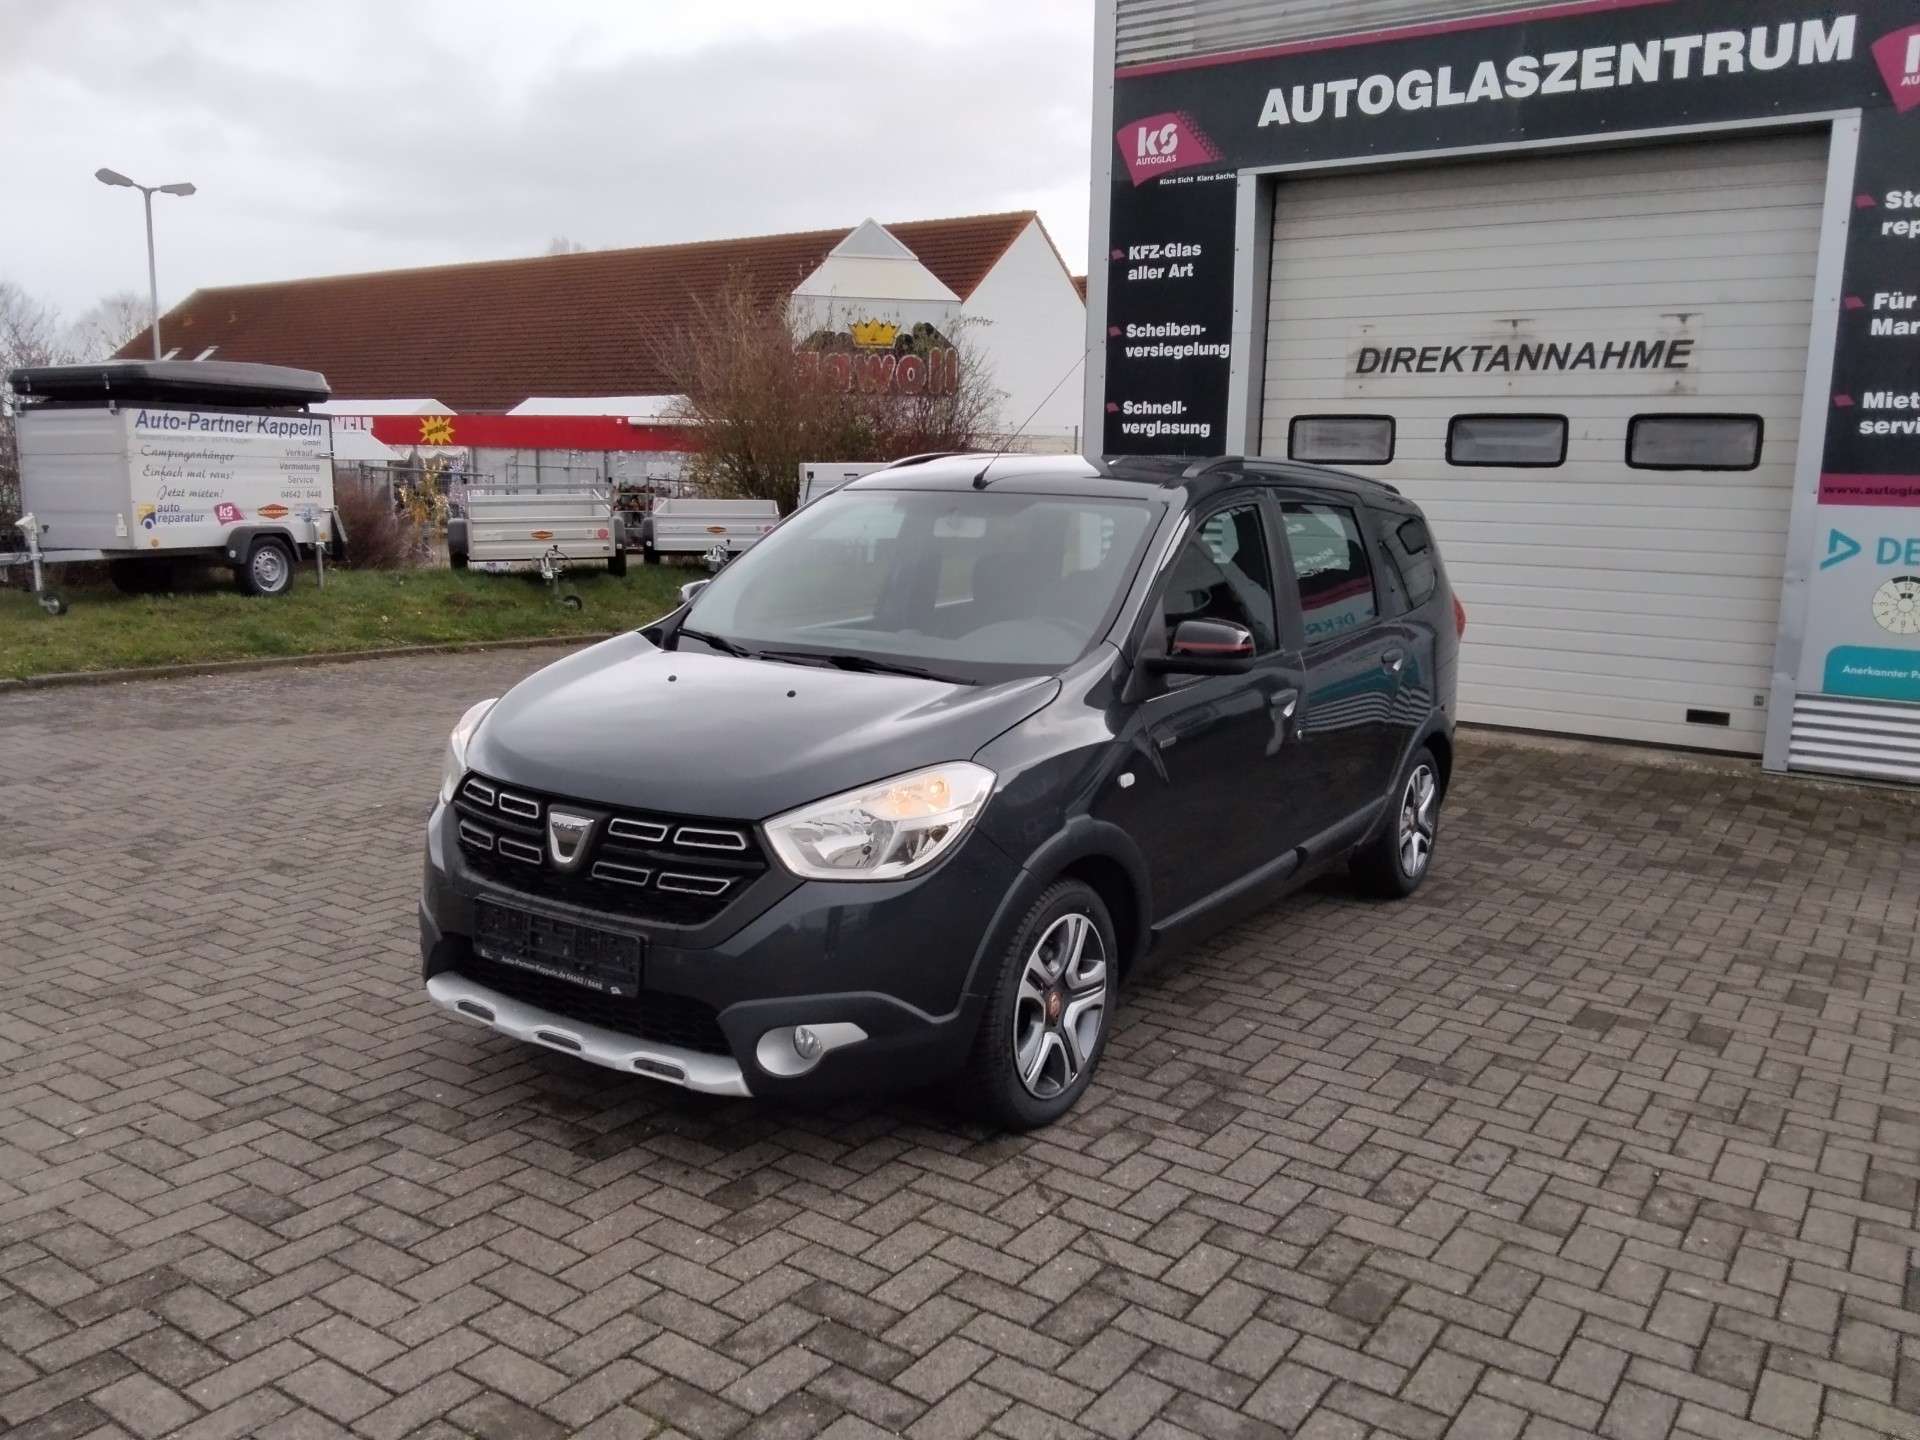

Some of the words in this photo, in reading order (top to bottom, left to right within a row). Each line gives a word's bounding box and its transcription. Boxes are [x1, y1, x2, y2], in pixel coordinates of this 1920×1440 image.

[1257, 15, 1857, 127] AUTOGLASZENTRUM
[1136, 155, 1177, 166] AUTOGLAS
[1885, 190, 1920, 209] St
[1881, 220, 1920, 239] rep
[1128, 243, 1202, 261] KFZ-Glas
[1127, 265, 1165, 280] aller
[1168, 263, 1194, 278] Art
[1873, 291, 1917, 310] Für
[1126, 322, 1207, 338] Scheiben-
[1870, 318, 1920, 336] Mar
[1125, 342, 1230, 360] versiegelung
[1355, 339, 1695, 374] DIREKTANNAHME
[1123, 401, 1187, 415] Schnell-
[135, 409, 253, 433] Auto-Partner
[257, 417, 322, 438] Kappeln
[1122, 420, 1210, 438] verglasung
[142, 464, 183, 481] Einfach
[187, 470, 207, 479] mal
[280, 463, 320, 472] Vermietung
[288, 475, 314, 485] Service
[157, 485, 185, 501] Jetzt
[157, 504, 180, 513] auto
[157, 513, 205, 525] reparatur
[1842, 665, 1909, 678] Anerkannter
